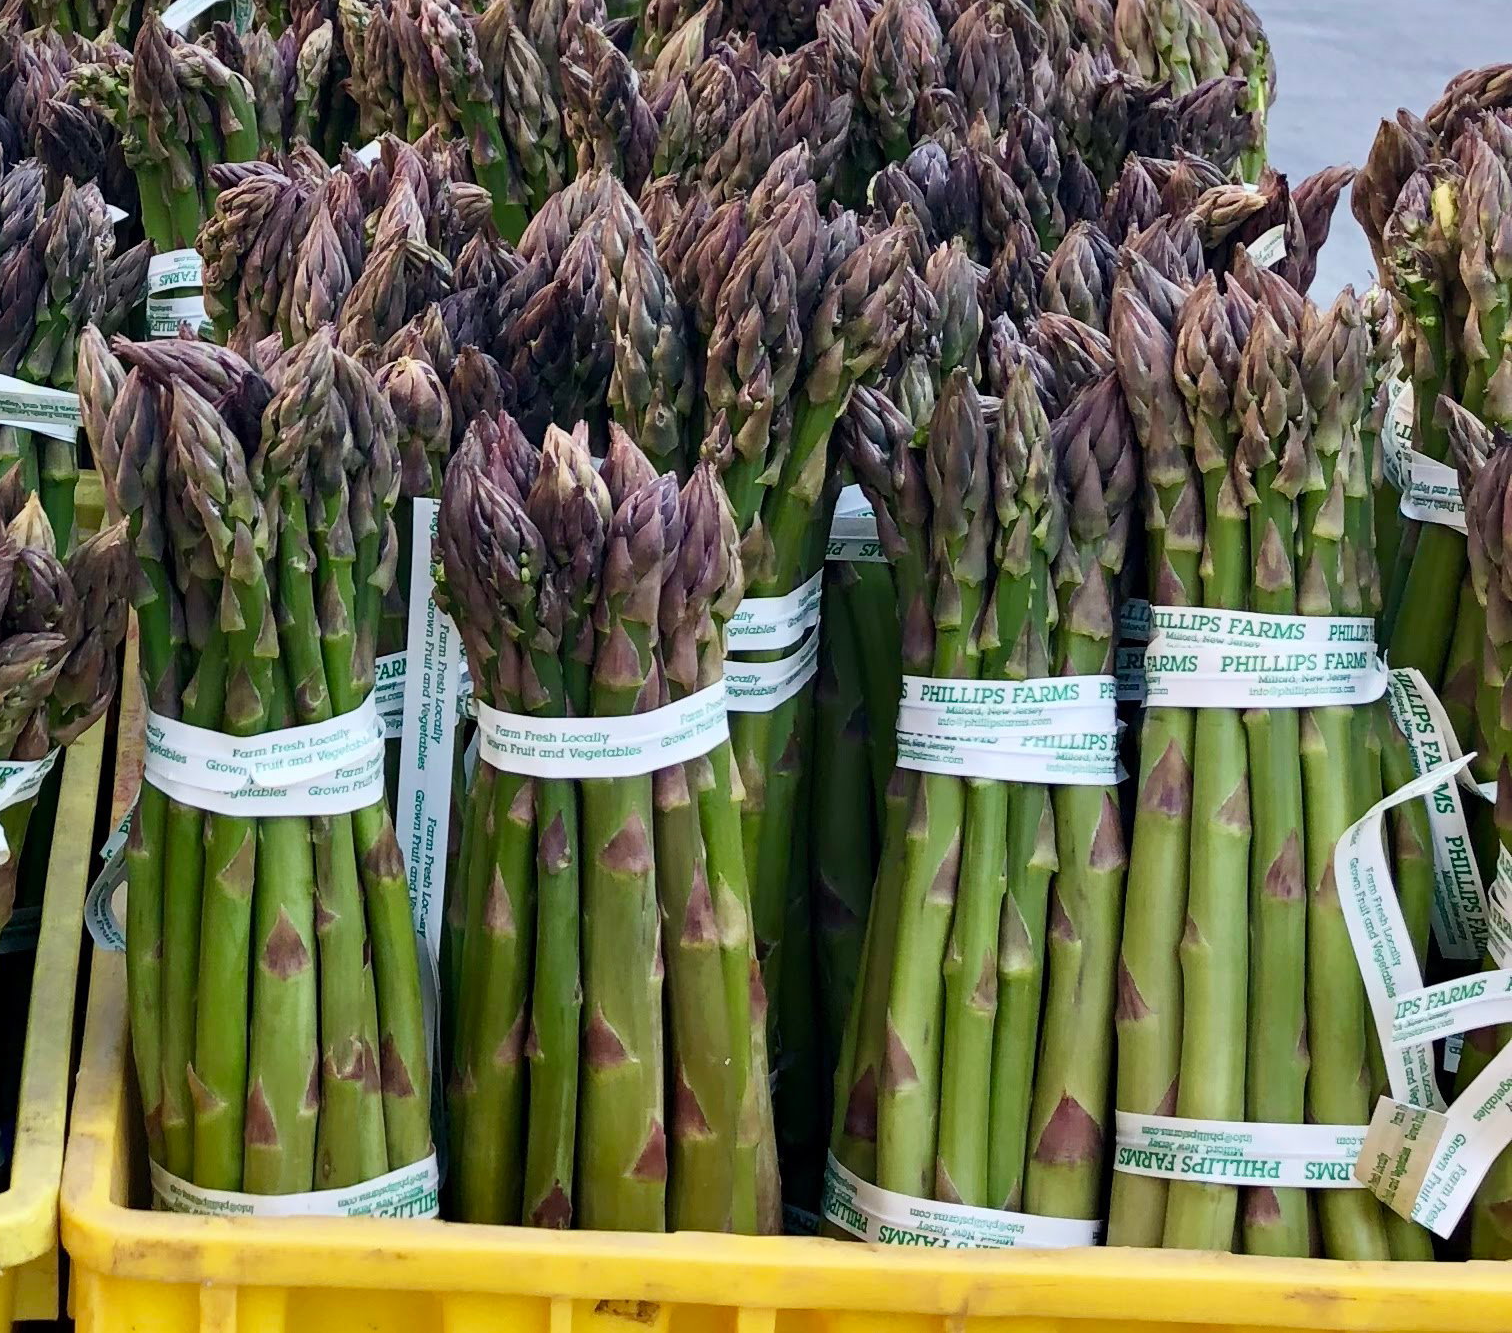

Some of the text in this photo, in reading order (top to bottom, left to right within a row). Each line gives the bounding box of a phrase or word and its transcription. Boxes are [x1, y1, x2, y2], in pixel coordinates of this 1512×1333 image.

[158, 271, 198, 287] FARMS
[1165, 631, 1261, 649] Milford, New Jersey
[1227, 618, 1307, 641] FARMS
[423, 641, 434, 670] Fruit
[1220, 653, 1318, 673] PHILLIPS
[1324, 651, 1367, 670] FARMS
[423, 673, 431, 698] and
[431, 624, 450, 744] Farm Fresh Locally
[1257, 673, 1352, 684] Milford, New Jersey
[920, 684, 1005, 704] PHILLIPS
[1011, 683, 1080, 704] FARMS
[1248, 685, 1356, 697] info@phillipsfarms.com
[937, 716, 1053, 729] info@phillipsfarms.com
[945, 705, 1044, 717] Milford, New Jersey
[417, 703, 430, 771] Vegetables
[495, 724, 610, 747] Farm Fresh Locally
[660, 720, 717, 748] Grown Fruit
[1401, 719, 1414, 739] New
[232, 728, 351, 759] Farm Fresh Locally
[510, 744, 643, 760] Fruit and Vegetables
[205, 755, 312, 777] Grown Fruit and
[1055, 751, 1090, 763] Milford,
[334, 766, 364, 779] Farm
[308, 776, 373, 797] Grown Fruit
[414, 789, 424, 826] Grown
[1420, 737, 1481, 914] FAMS PHILLIPS
[412, 828, 422, 862] Fruit
[425, 817, 438, 886] Farm Fresh
[1364, 866, 1402, 967] Farm Fresh Locally
[1348, 857, 1397, 1000] Grown Fruit and Vegetables
[1426, 979, 1487, 1012] FARMS
[1141, 1125, 1253, 1145] info@phillipsfarms.com
[1118, 1147, 1175, 1171] FARMS
[1147, 1137, 1245, 1158] Milford, New Jersey
[1180, 1156, 1281, 1179] PHILLIPS
[1414, 1132, 1468, 1206] Grown Fruit
[1447, 1163, 1468, 1195] Farm
[909, 1207, 1026, 1235] info@phillipsfarms.com
[916, 1220, 976, 1240] New Jersey
